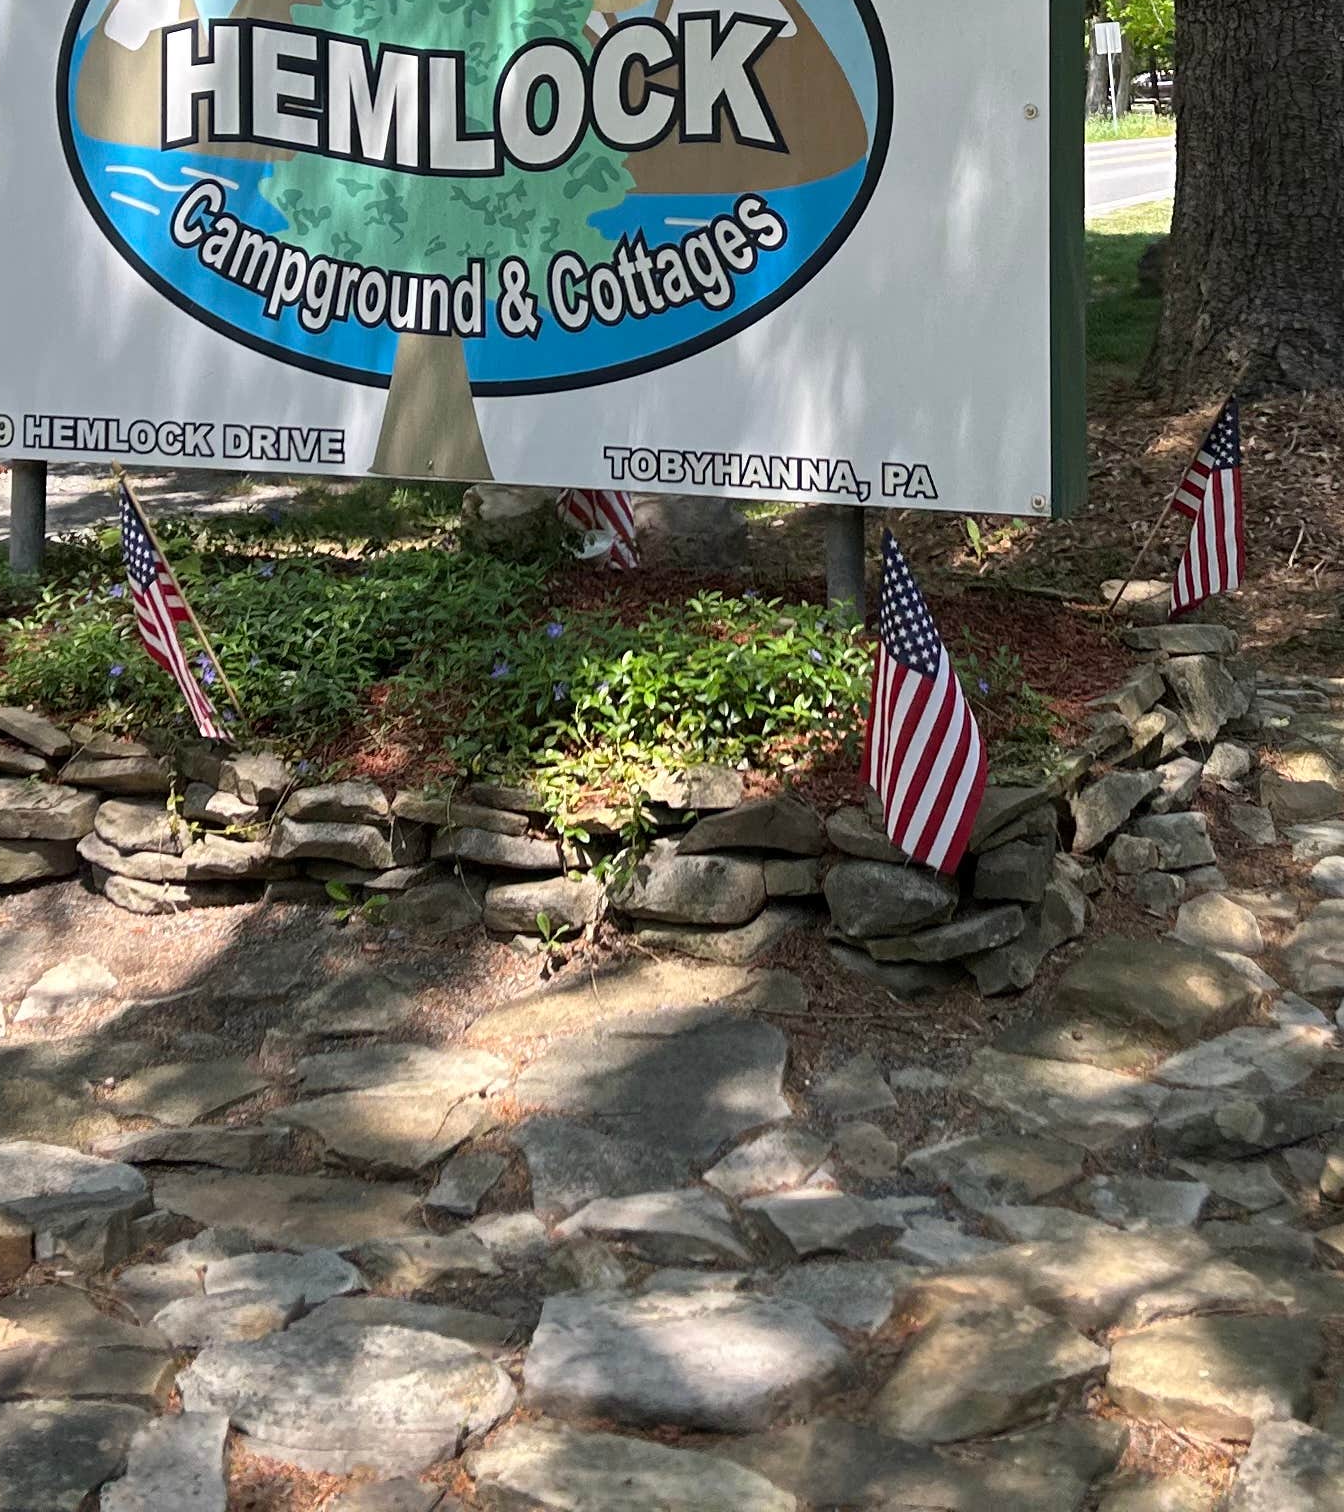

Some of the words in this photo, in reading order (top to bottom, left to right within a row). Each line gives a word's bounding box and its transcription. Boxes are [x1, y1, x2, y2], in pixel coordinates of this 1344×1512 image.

[162, 10, 794, 178] HEMLOCK
[170, 179, 487, 337] Campground
[497, 256, 541, 341] &
[548, 192, 787, 331] Cottages
[23, 414, 215, 458] HEMLOCK
[223, 424, 346, 464] DRIVE
[603, 446, 871, 502] TOBYHANNA,
[882, 462, 939, 499] PA
